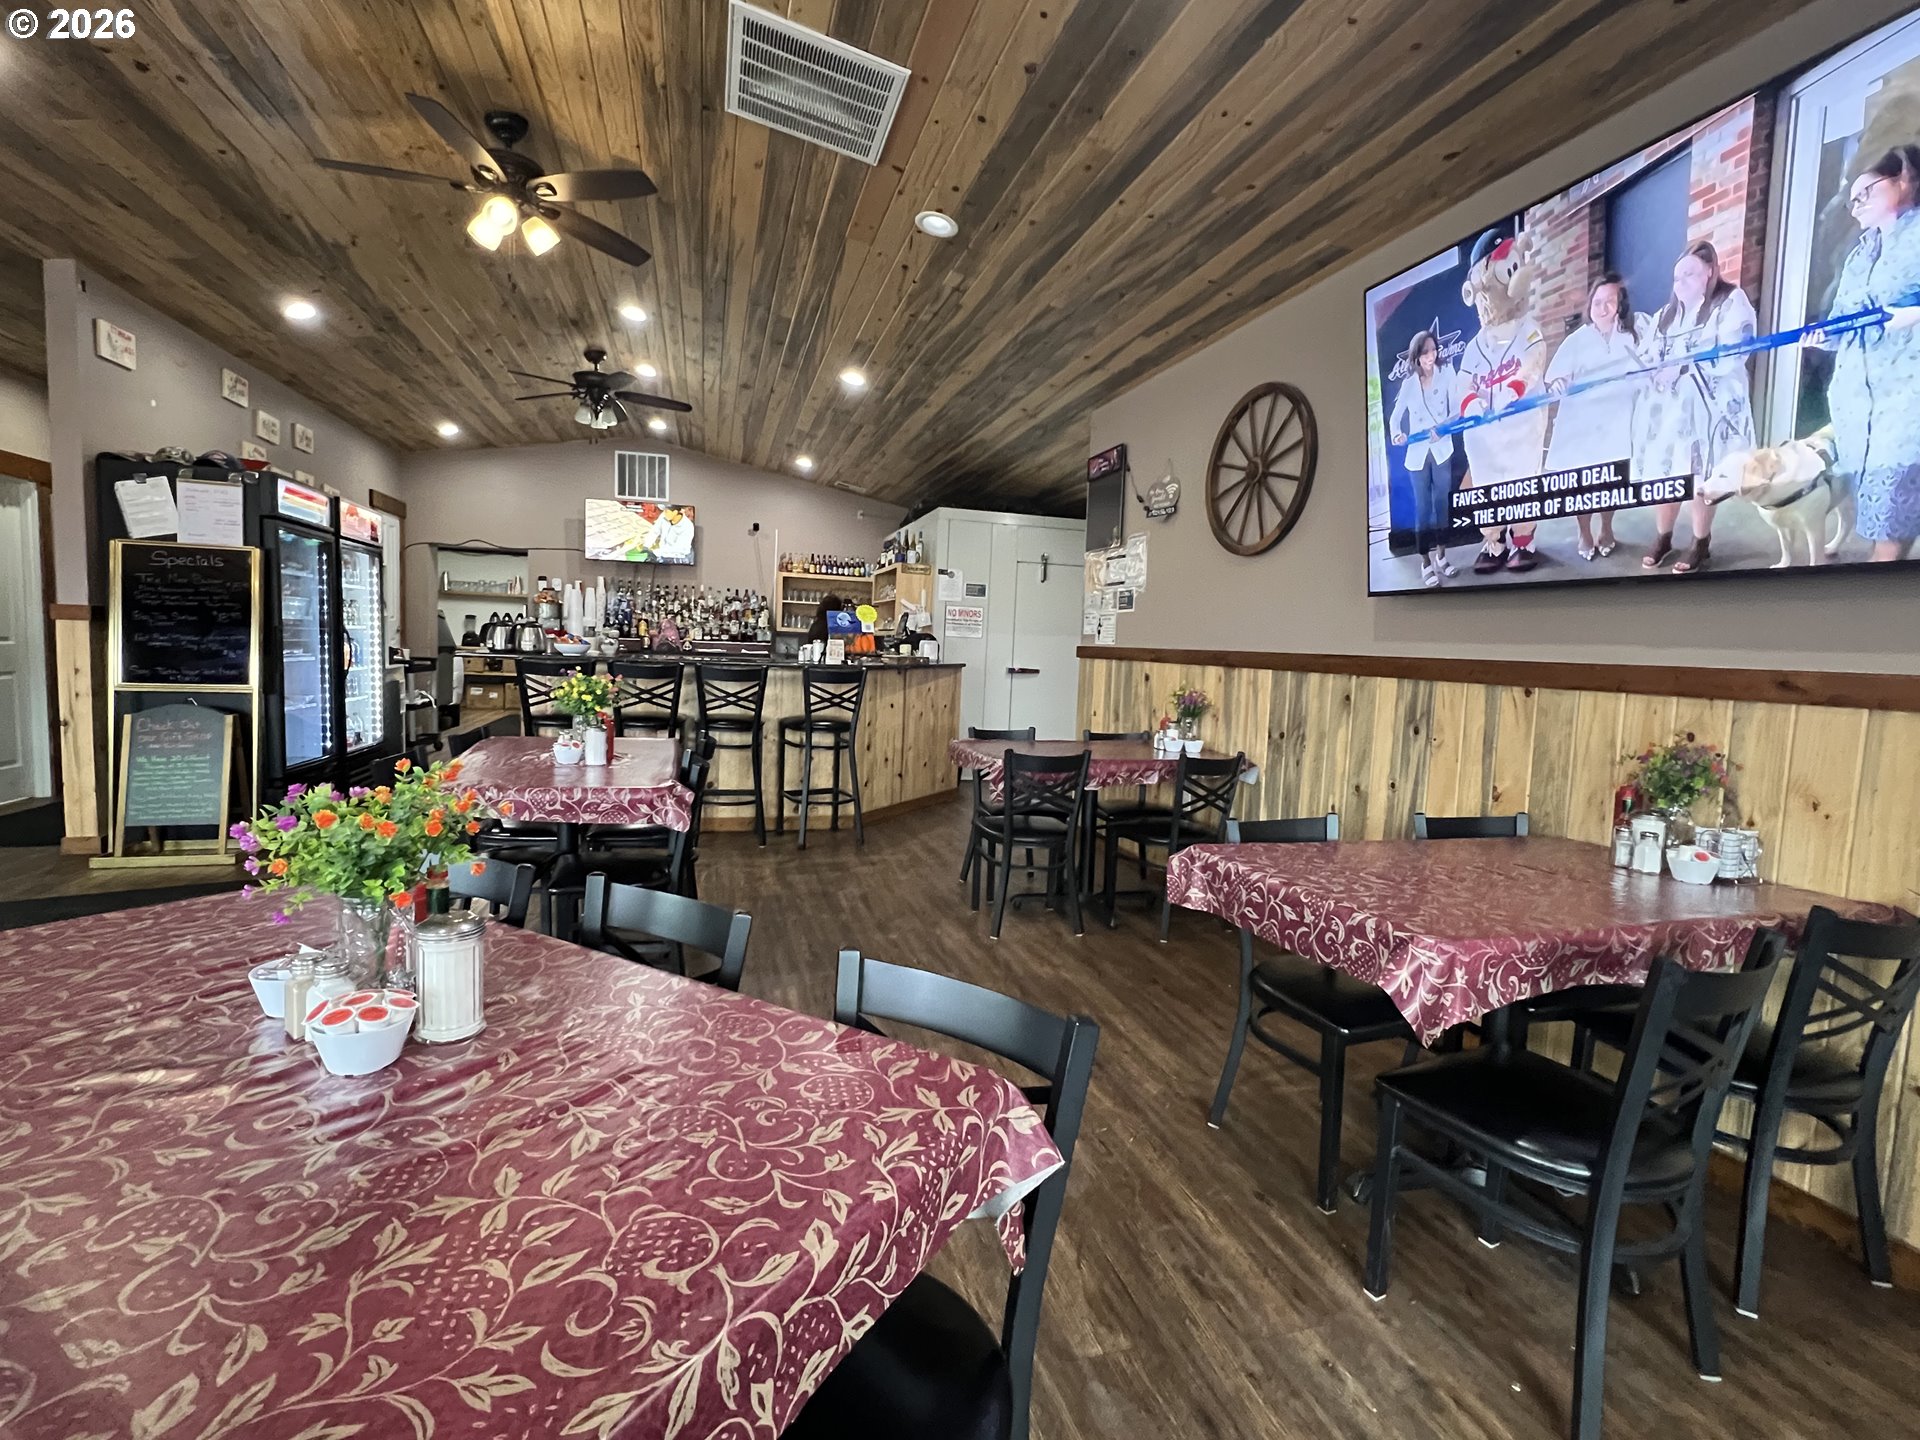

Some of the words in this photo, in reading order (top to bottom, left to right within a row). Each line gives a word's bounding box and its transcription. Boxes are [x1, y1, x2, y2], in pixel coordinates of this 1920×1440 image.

[1453, 489, 1488, 508] FAVES.
[1490, 479, 1539, 502] CHOOSE
[1542, 472, 1578, 493] YOUR
[1582, 464, 1622, 487] DEAL.
[1473, 508, 1495, 525] THE
[1497, 501, 1541, 522] POWER
[1544, 498, 1562, 515] OF
[1565, 486, 1637, 513] BASEBALL
[1641, 479, 1686, 502] GOES
[149, 550, 225, 569] Specials
[947, 609, 957, 618] NO
[958, 609, 982, 619] MINORS
